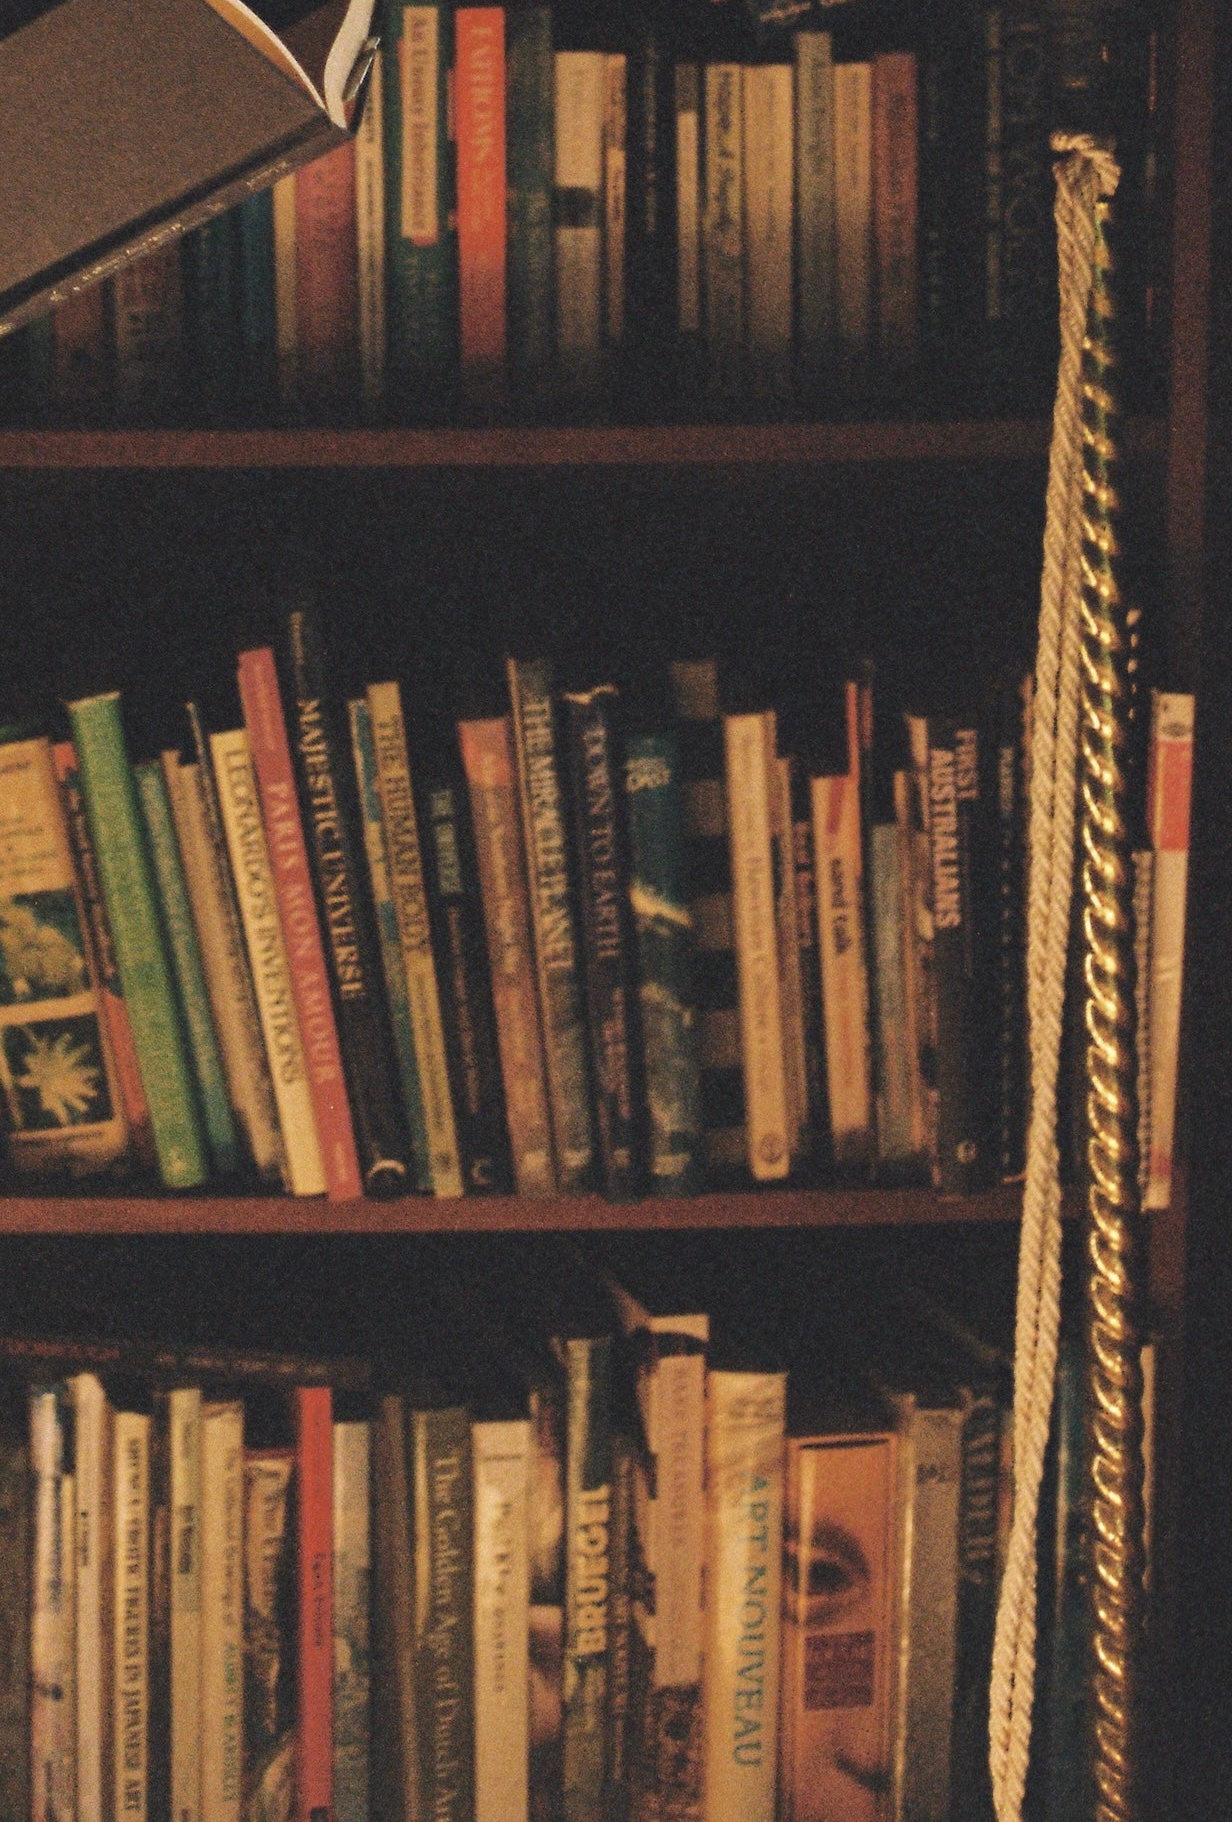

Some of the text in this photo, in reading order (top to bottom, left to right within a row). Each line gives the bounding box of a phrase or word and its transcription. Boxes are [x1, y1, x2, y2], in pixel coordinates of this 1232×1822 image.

[411, 15, 430, 44] An
[470, 25, 494, 163] FATHOMS
[582, 727, 615, 820] DOWN
[953, 727, 981, 803] FIRST
[297, 696, 340, 846] MAJESTIC
[322, 849, 368, 1002] UNIVERSE
[377, 716, 431, 958] THE HUMAN BODY
[523, 698, 575, 973] THE MIRACLE PLANET
[588, 828, 616, 863] TO
[929, 747, 962, 931] AUSTRALIANS
[225, 748, 301, 1086] LEONARDO'S INVENTIONS
[266, 780, 339, 1085] PARIS MON AMOUR
[591, 870, 622, 960] EARTH
[432, 1455, 460, 1505] The
[430, 1509, 459, 1606] Golden
[575, 1484, 612, 1658] BRUEGEL
[123, 1586, 142, 1660] FIGURES
[426, 1611, 458, 1661] Age
[732, 1473, 773, 1770] ART NOUVEAU
[124, 1665, 142, 1683] IN
[433, 1664, 457, 1691] of
[121, 1689, 143, 1771] JAPANESE
[432, 1697, 457, 1779] Dutch
[123, 1779, 141, 1813] ART
